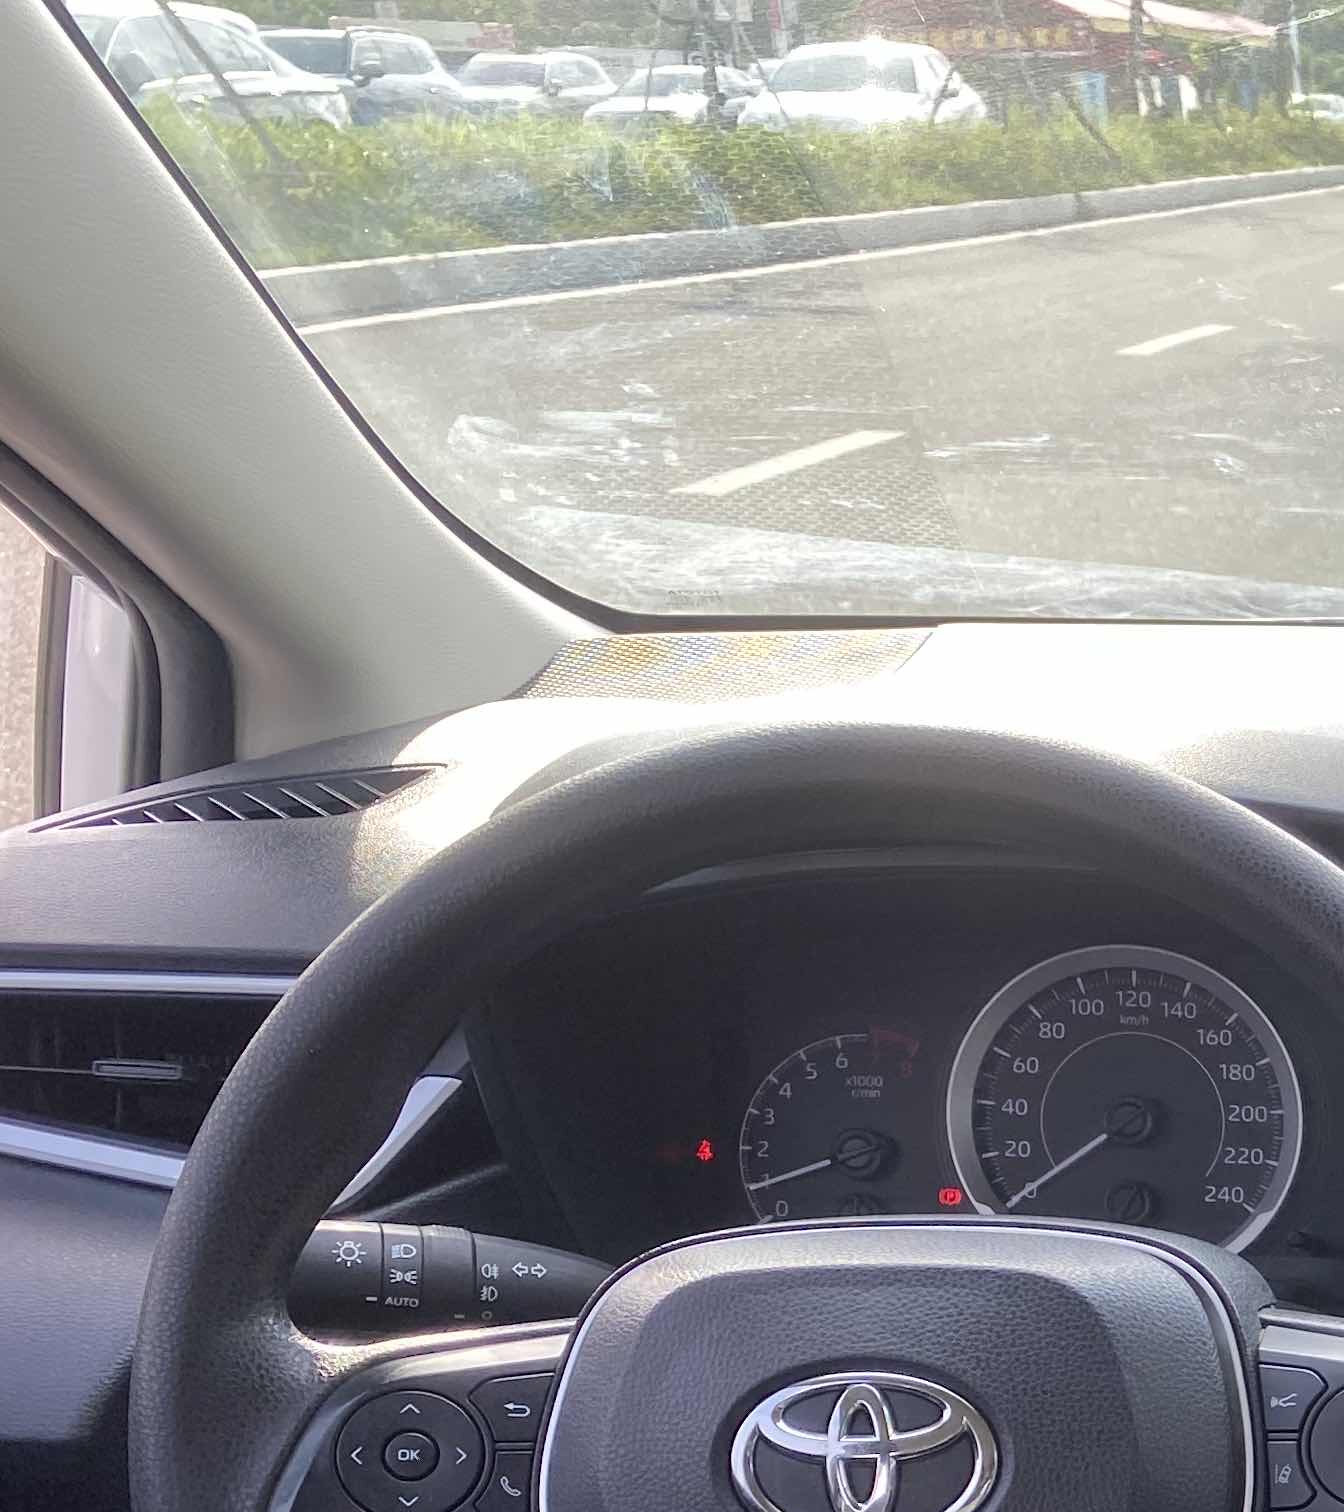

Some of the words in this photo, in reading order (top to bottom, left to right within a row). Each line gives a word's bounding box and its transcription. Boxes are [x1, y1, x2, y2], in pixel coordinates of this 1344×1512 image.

[1070, 999, 1104, 1015] 100
[1116, 991, 1151, 1008] 120
[1161, 1002, 1196, 1019] 140
[1120, 1014, 1149, 1026] km/h
[1039, 1022, 1065, 1039] 80
[1197, 1029, 1232, 1046] 160
[835, 1053, 848, 1069] 6
[1013, 1057, 1039, 1073] 60
[805, 1063, 818, 1079] 5
[1220, 1064, 1255, 1081] 180
[779, 1083, 792, 1098] 4
[1001, 1099, 1028, 1116] 40
[1228, 1105, 1267, 1122] 200
[764, 1108, 775, 1125] 3
[757, 1141, 769, 1157] 2
[1004, 1141, 1031, 1158] 20
[1224, 1148, 1264, 1165] 220
[1204, 1186, 1243, 1203] 240
[776, 1200, 788, 1216] 0
[384, 1295, 420, 1308] AUTO
[398, 1449, 421, 1461] OK
